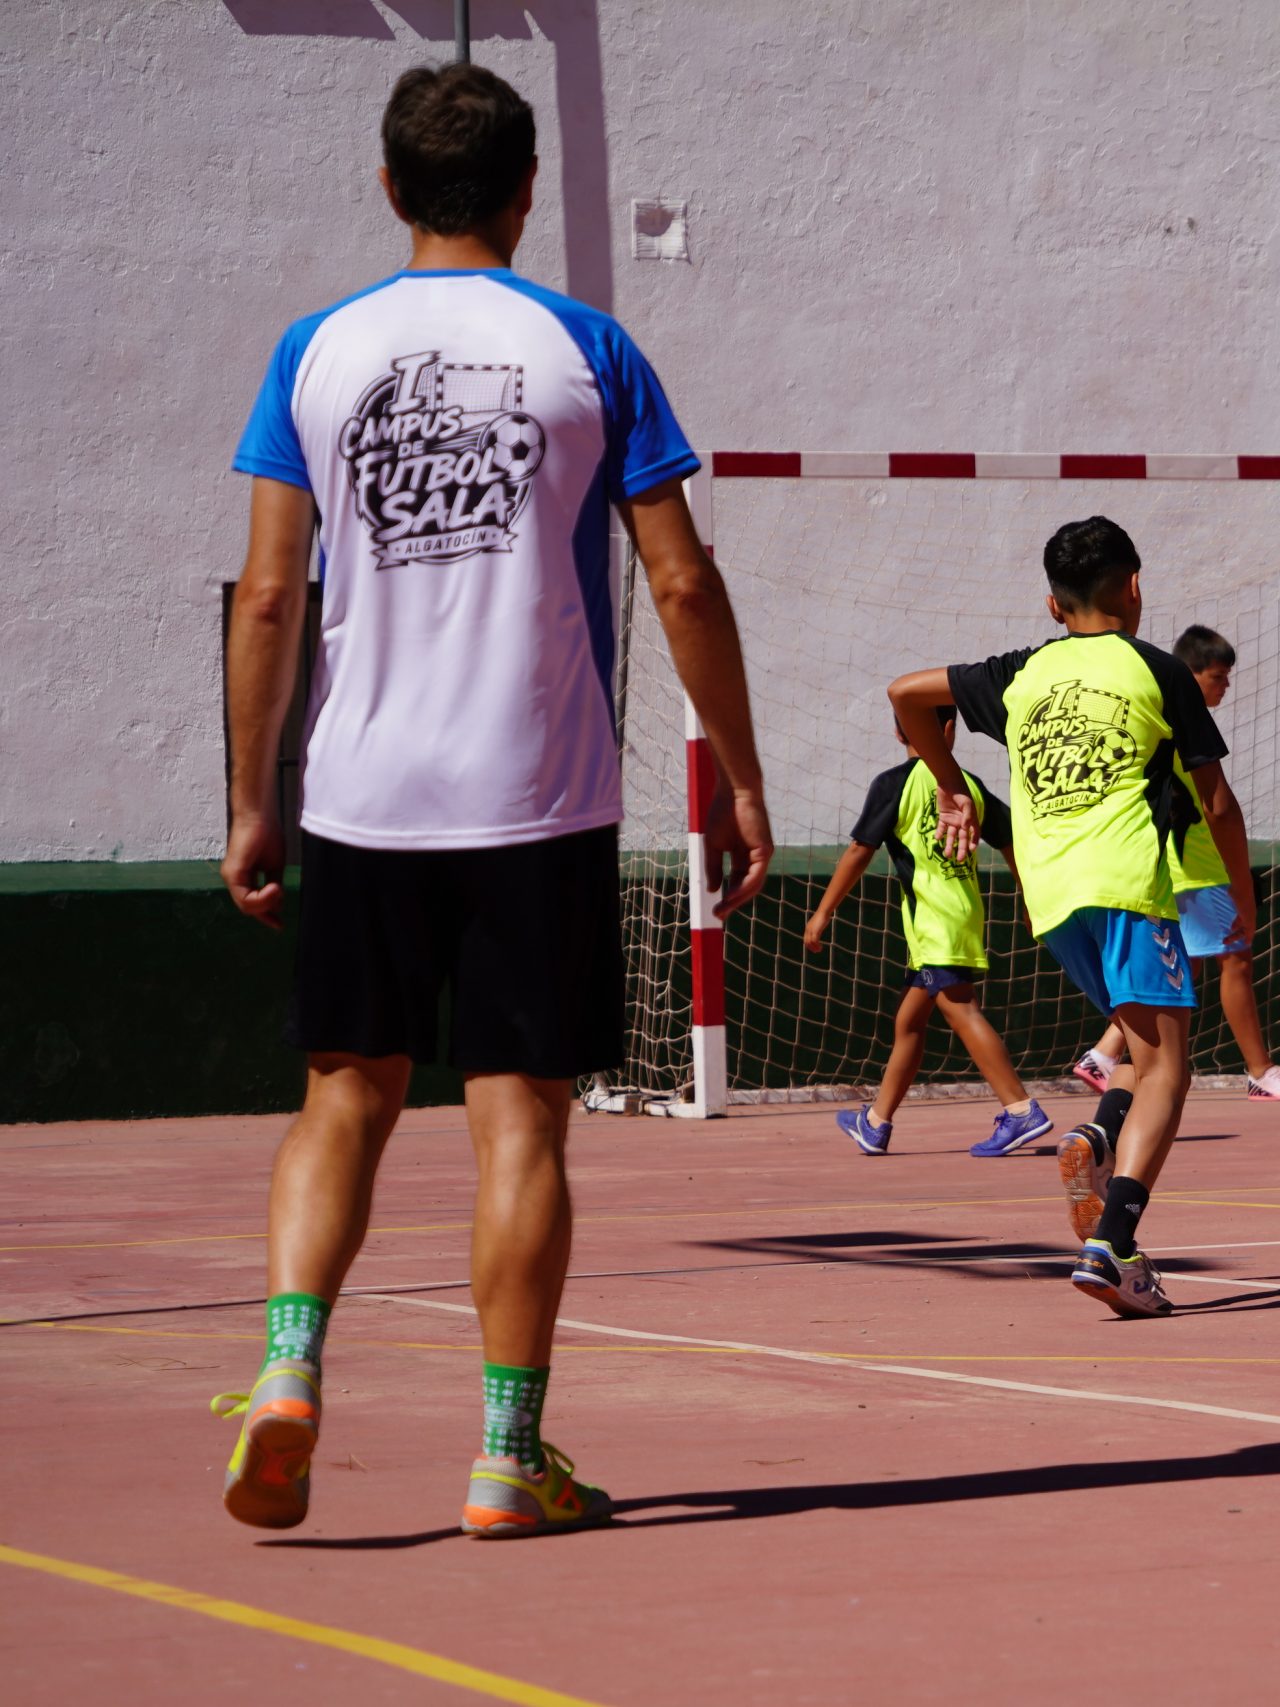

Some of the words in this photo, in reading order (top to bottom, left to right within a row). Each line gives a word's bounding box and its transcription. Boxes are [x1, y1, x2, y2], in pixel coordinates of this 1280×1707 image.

[390, 350, 440, 416] I
[340, 406, 463, 458] CAMPUS
[398, 440, 425, 459] DE
[355, 446, 508, 520] FUTBOL
[374, 482, 514, 542] SALA
[405, 528, 487, 554] ALGATOCÍN
[1051, 680, 1081, 720] I
[1018, 715, 1087, 750] CAMPUS
[1046, 737, 1064, 748] DE
[1022, 744, 1108, 782] FUTBOL
[1032, 766, 1106, 802] SALA
